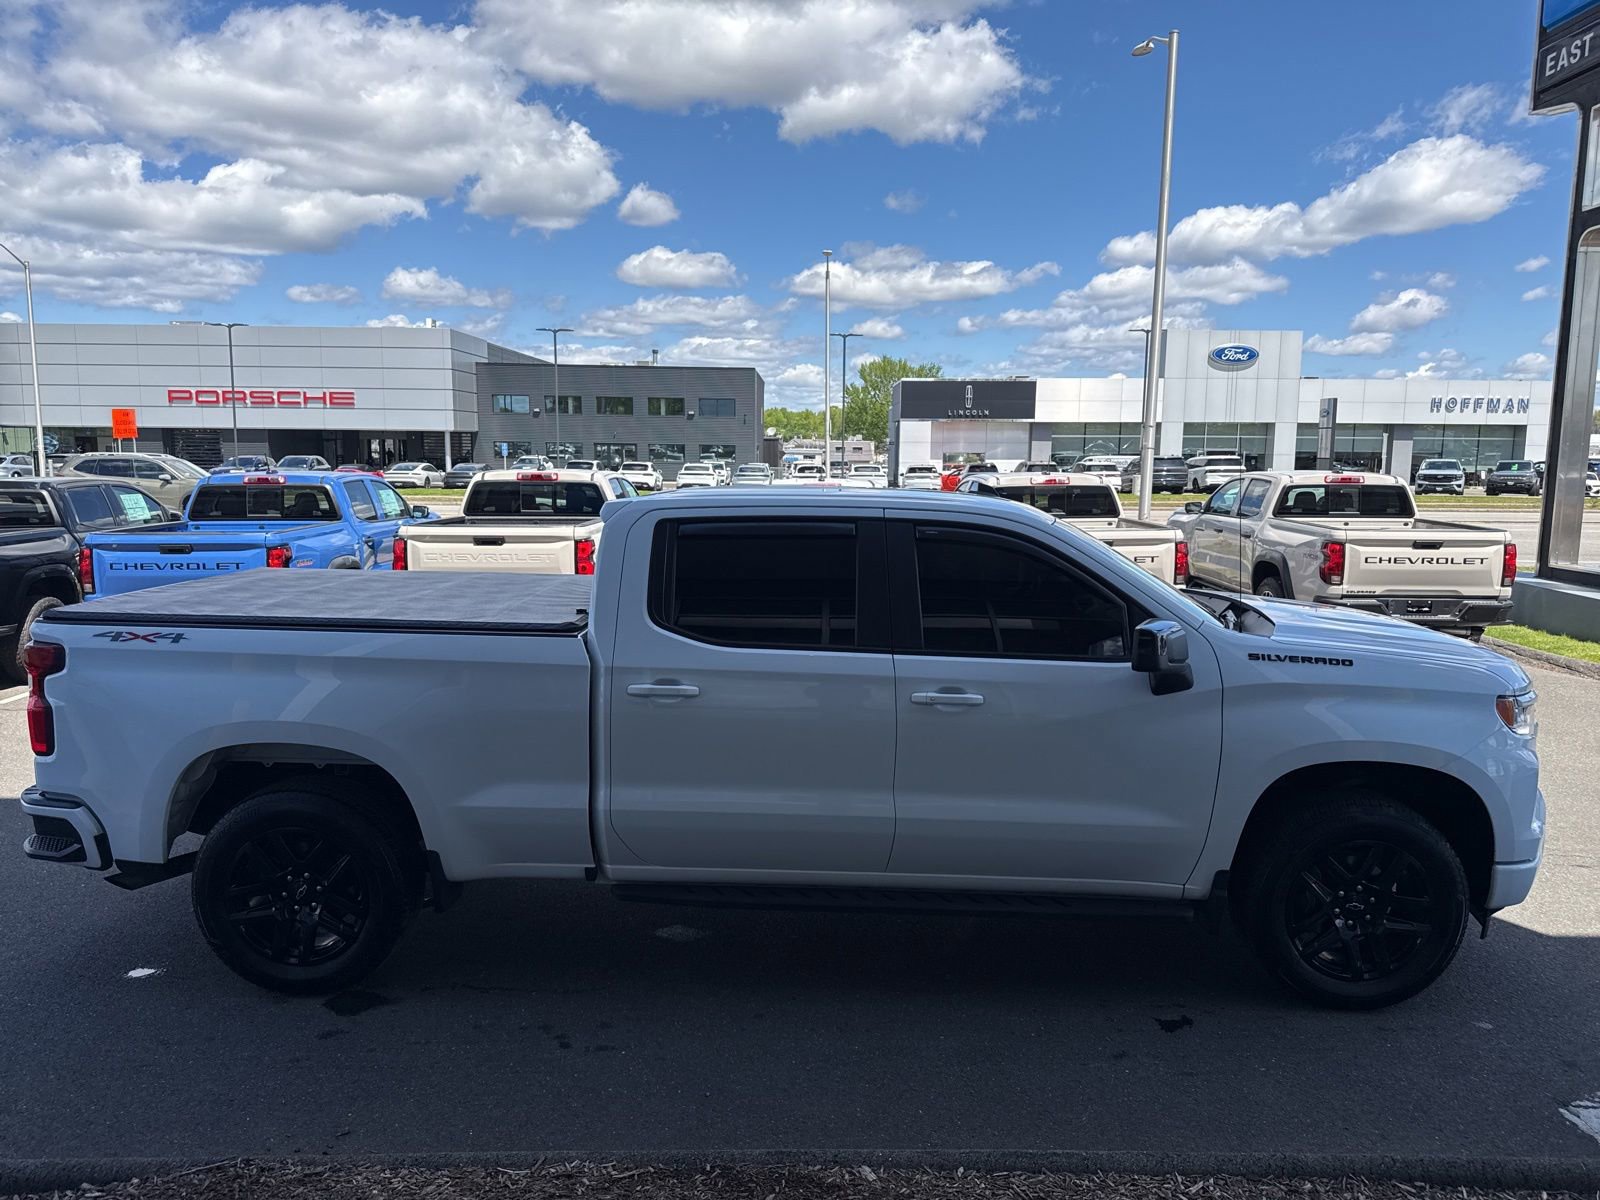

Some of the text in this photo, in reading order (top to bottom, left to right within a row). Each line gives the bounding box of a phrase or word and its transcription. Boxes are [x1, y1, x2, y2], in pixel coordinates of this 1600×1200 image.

[1545, 32, 1594, 77] EAST
[1221, 347, 1250, 361] Ford
[167, 389, 355, 407] PORSCHE
[1431, 397, 1530, 411] HOFFMAN
[424, 552, 555, 563] CHEVROLET
[1364, 556, 1489, 565] CHEVROLET
[109, 561, 246, 571] CHEVROLET
[1247, 652, 1354, 667] SILVERADO
